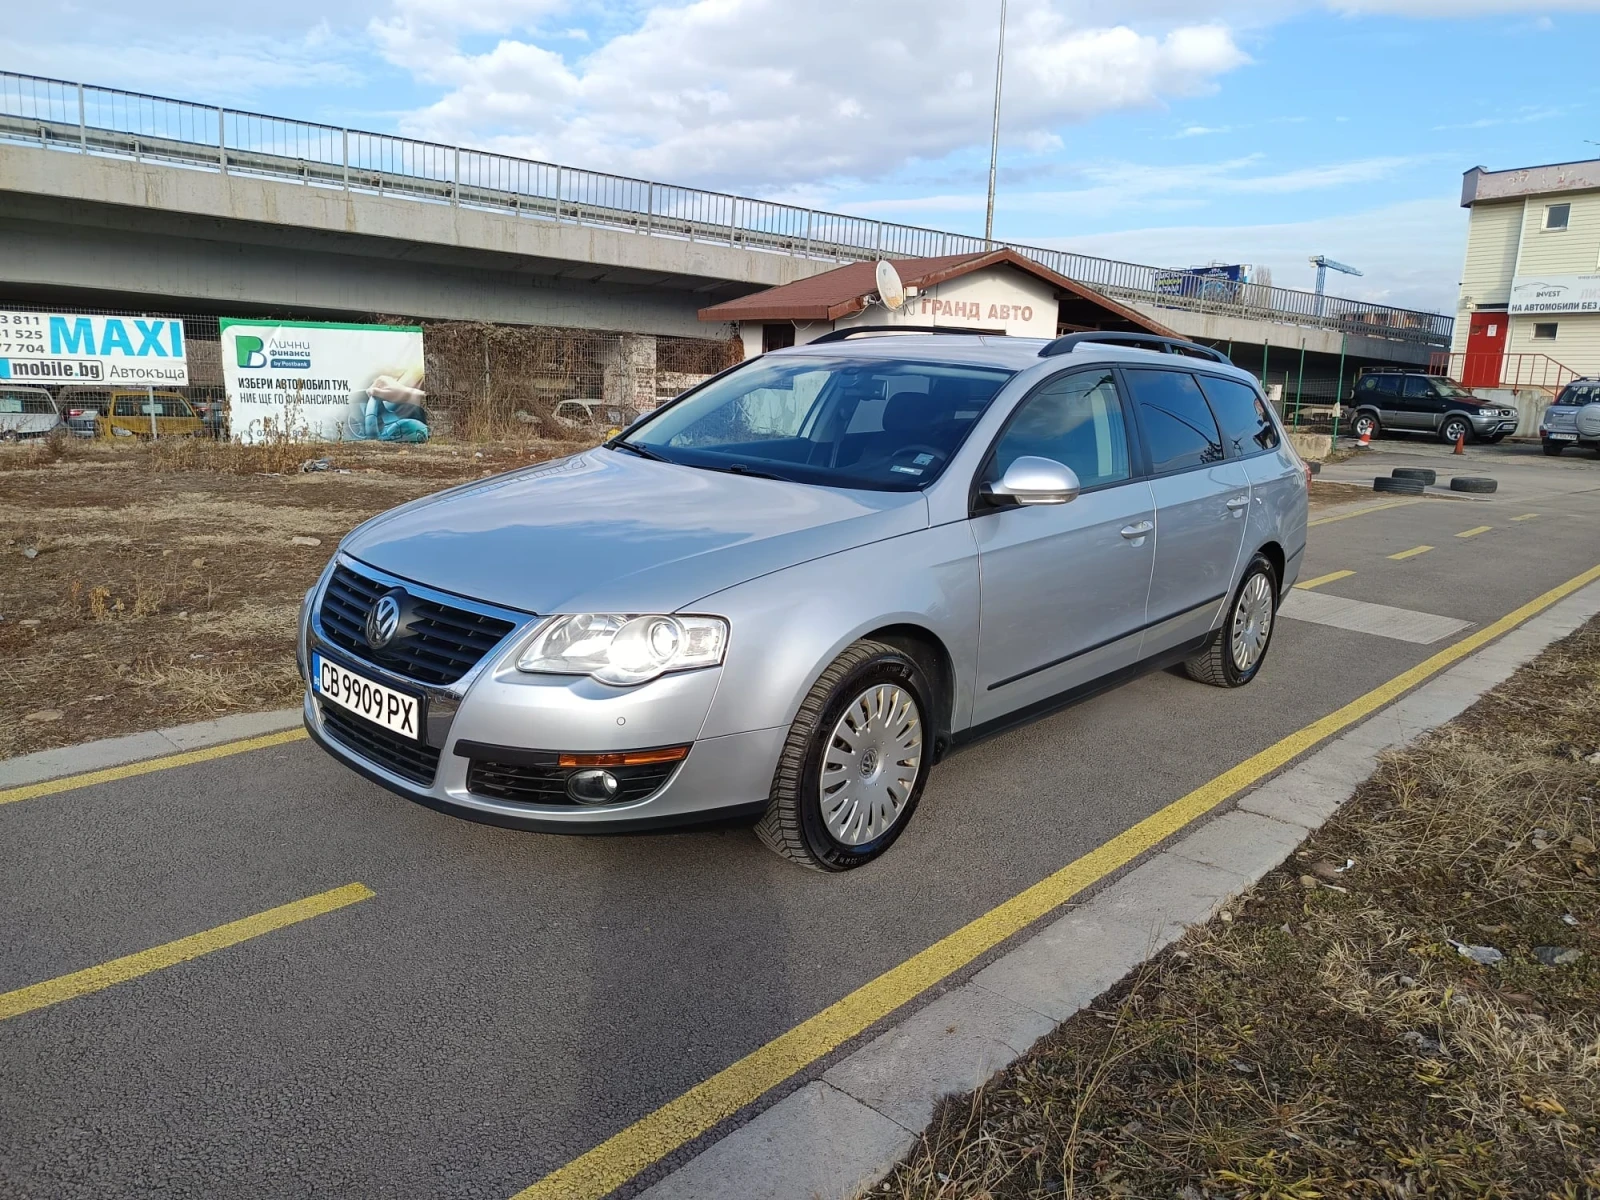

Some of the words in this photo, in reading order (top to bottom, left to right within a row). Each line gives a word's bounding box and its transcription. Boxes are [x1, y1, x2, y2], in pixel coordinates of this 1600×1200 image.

[921, 299, 980, 321] ГРАНД
[988, 303, 1033, 322] АВТО
[1524, 302, 1580, 311] АВТОМОБИЛИ
[1581, 302, 1598, 310] БЕЗ
[13, 315, 40, 325] 811
[15, 329, 43, 340] 525
[49, 316, 183, 358] MAXI
[16, 343, 45, 353] 704
[269, 337, 310, 350] Лични
[12, 361, 100, 379] mobile.bg
[109, 364, 185, 381] Автокъща
[238, 377, 273, 389] ИЗБЕРИ
[275, 378, 331, 390] АВТОМОБИЛ
[332, 380, 351, 392] ТУК,
[240, 393, 257, 403] НИЕ
[258, 393, 272, 405] ЩЕ
[274, 394, 284, 405] ГО
[322, 662, 340, 698] CB
[343, 674, 383, 719] 9909
[387, 693, 413, 734] PX
